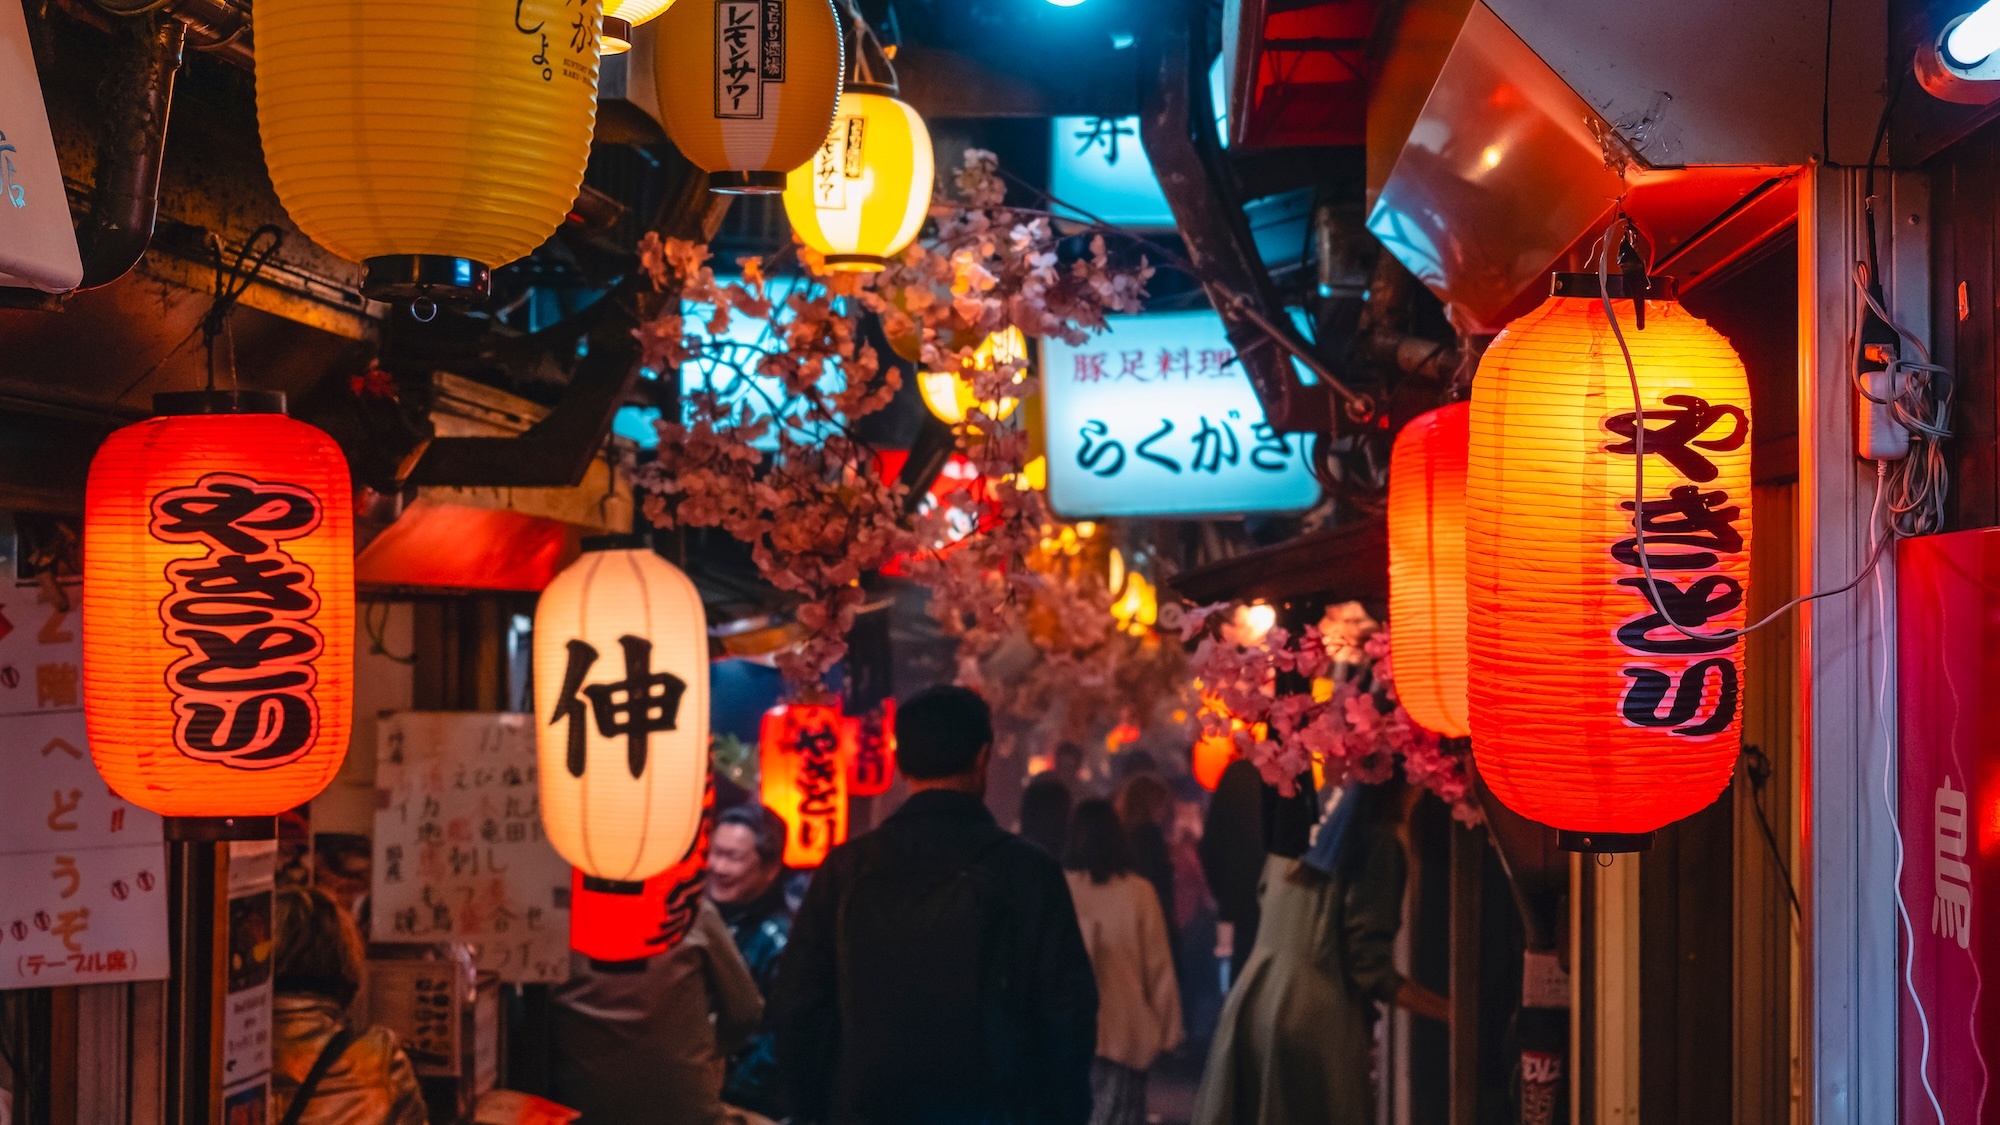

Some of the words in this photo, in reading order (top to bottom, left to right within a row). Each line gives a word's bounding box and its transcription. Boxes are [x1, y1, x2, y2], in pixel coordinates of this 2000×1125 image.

[722, 5, 756, 110] レモンサワー
[1072, 347, 1238, 383] 豚足料理
[1076, 410, 1294, 478] らくがき
[152, 476, 321, 767] やきとり
[1604, 394, 1749, 737] やきとり
[549, 634, 687, 780] 伸
